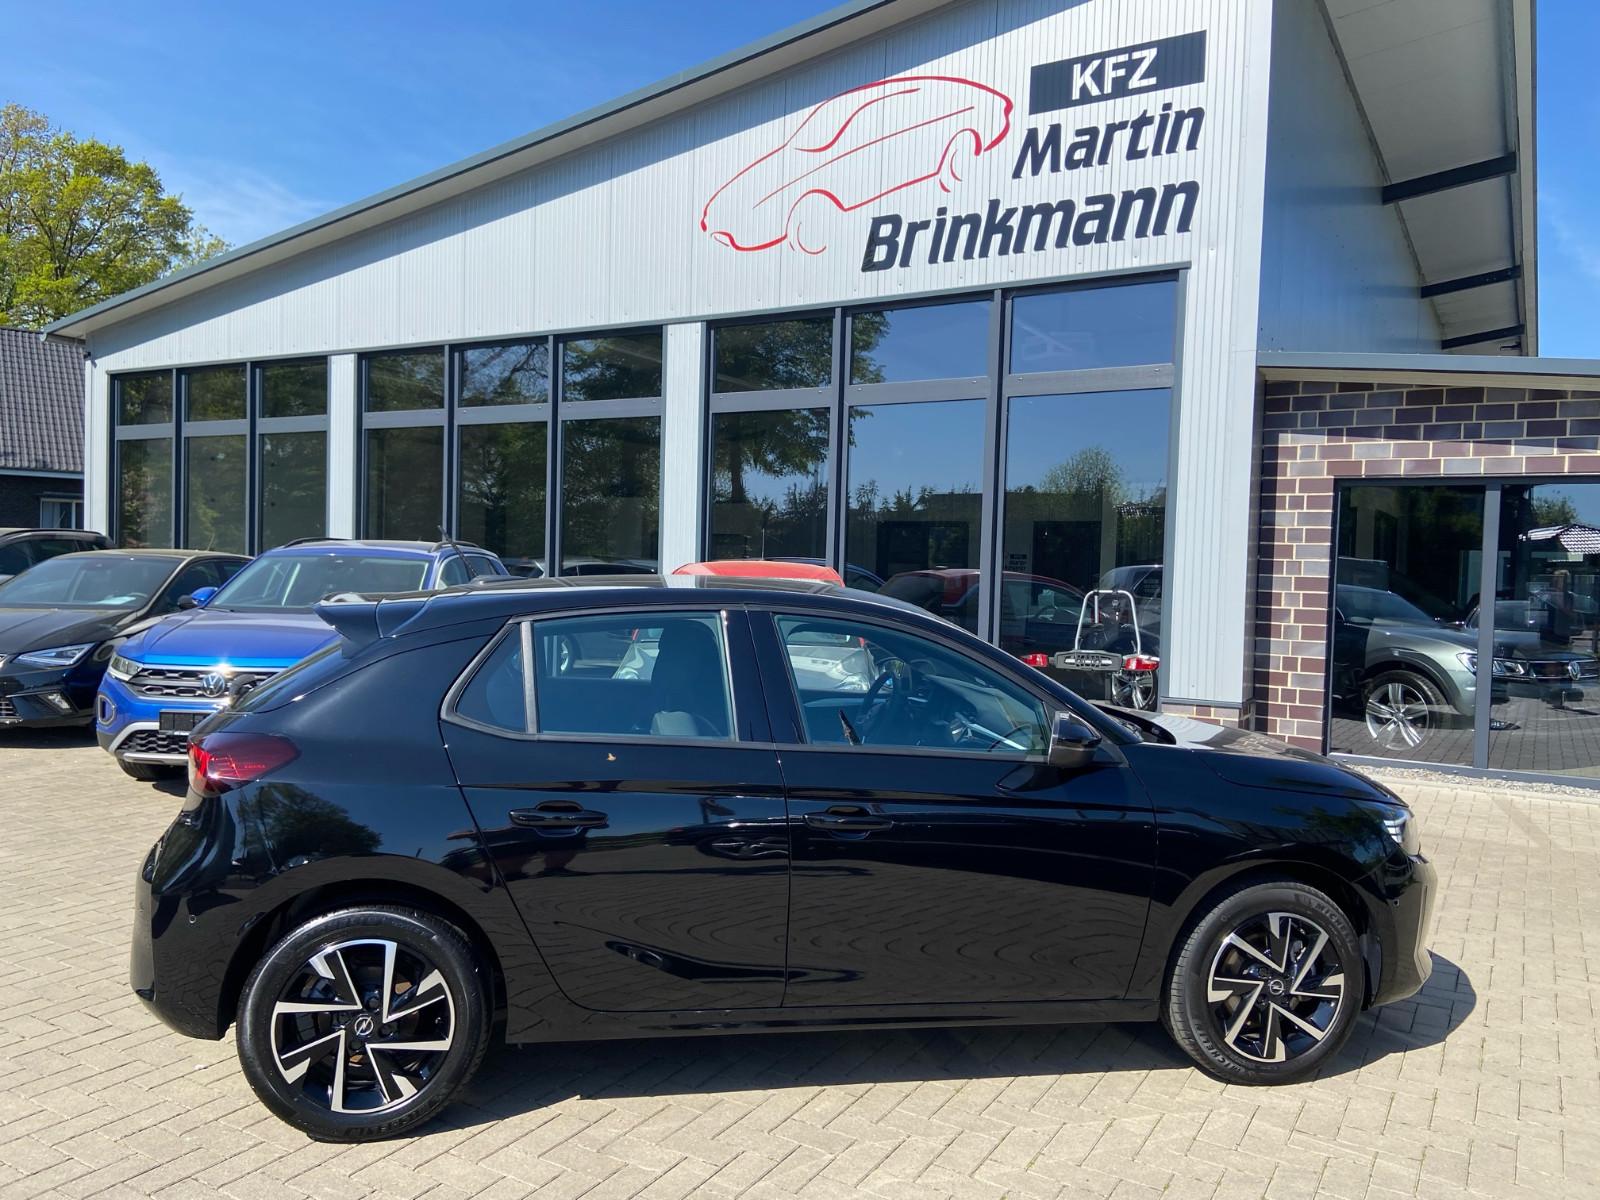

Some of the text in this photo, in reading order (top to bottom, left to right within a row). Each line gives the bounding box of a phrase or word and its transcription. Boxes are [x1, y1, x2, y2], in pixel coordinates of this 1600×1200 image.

[1072, 48, 1158, 100] KFZ
[1012, 102, 1205, 180] Martin
[861, 180, 1200, 272] Brinkmann
